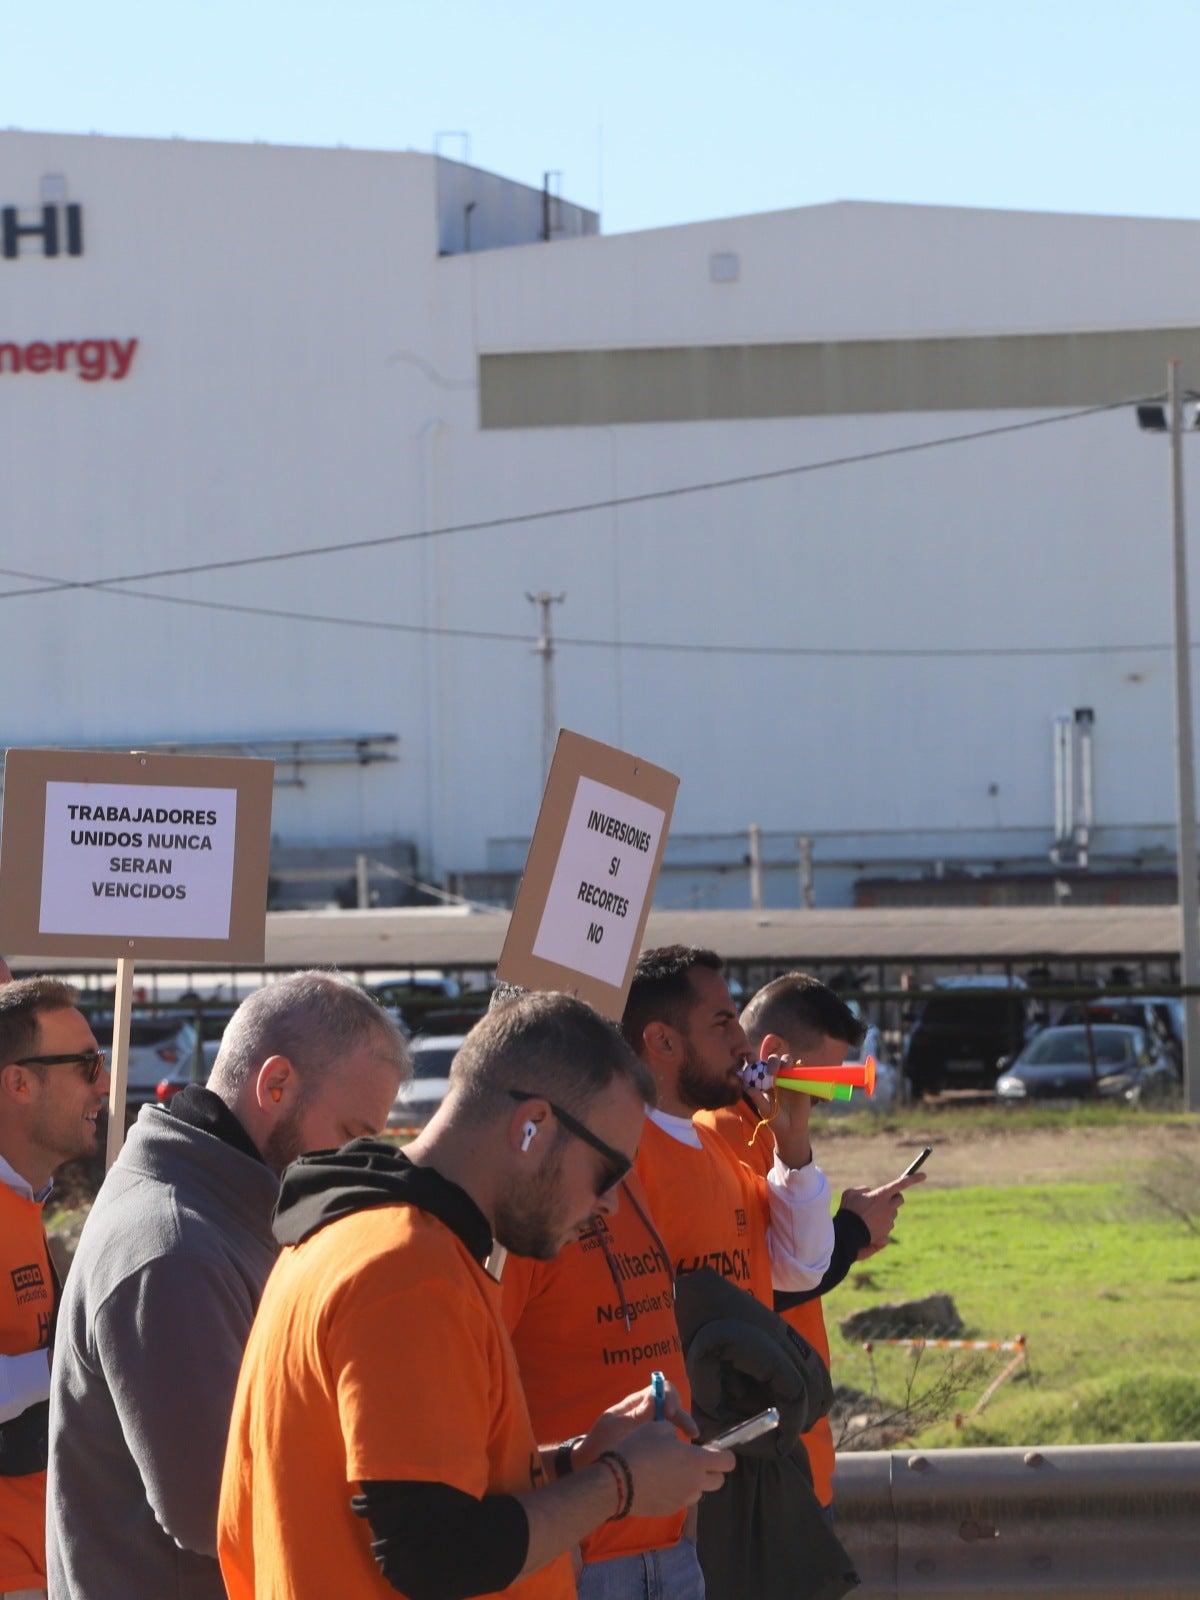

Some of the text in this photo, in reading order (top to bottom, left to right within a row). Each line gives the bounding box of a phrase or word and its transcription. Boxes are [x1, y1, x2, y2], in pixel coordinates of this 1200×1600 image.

[67, 804, 217, 825] TRABAJADORES
[70, 830, 213, 850] UNIDOS NUNCA
[587, 809, 652, 853] INVERSIONES
[109, 857, 172, 874] SERAN
[608, 857, 621, 876] SI
[92, 881, 187, 899] VENCIDOS
[577, 881, 630, 918] RECORTES
[586, 922, 604, 944] NO
[602, 1340, 671, 1366] Imponer
